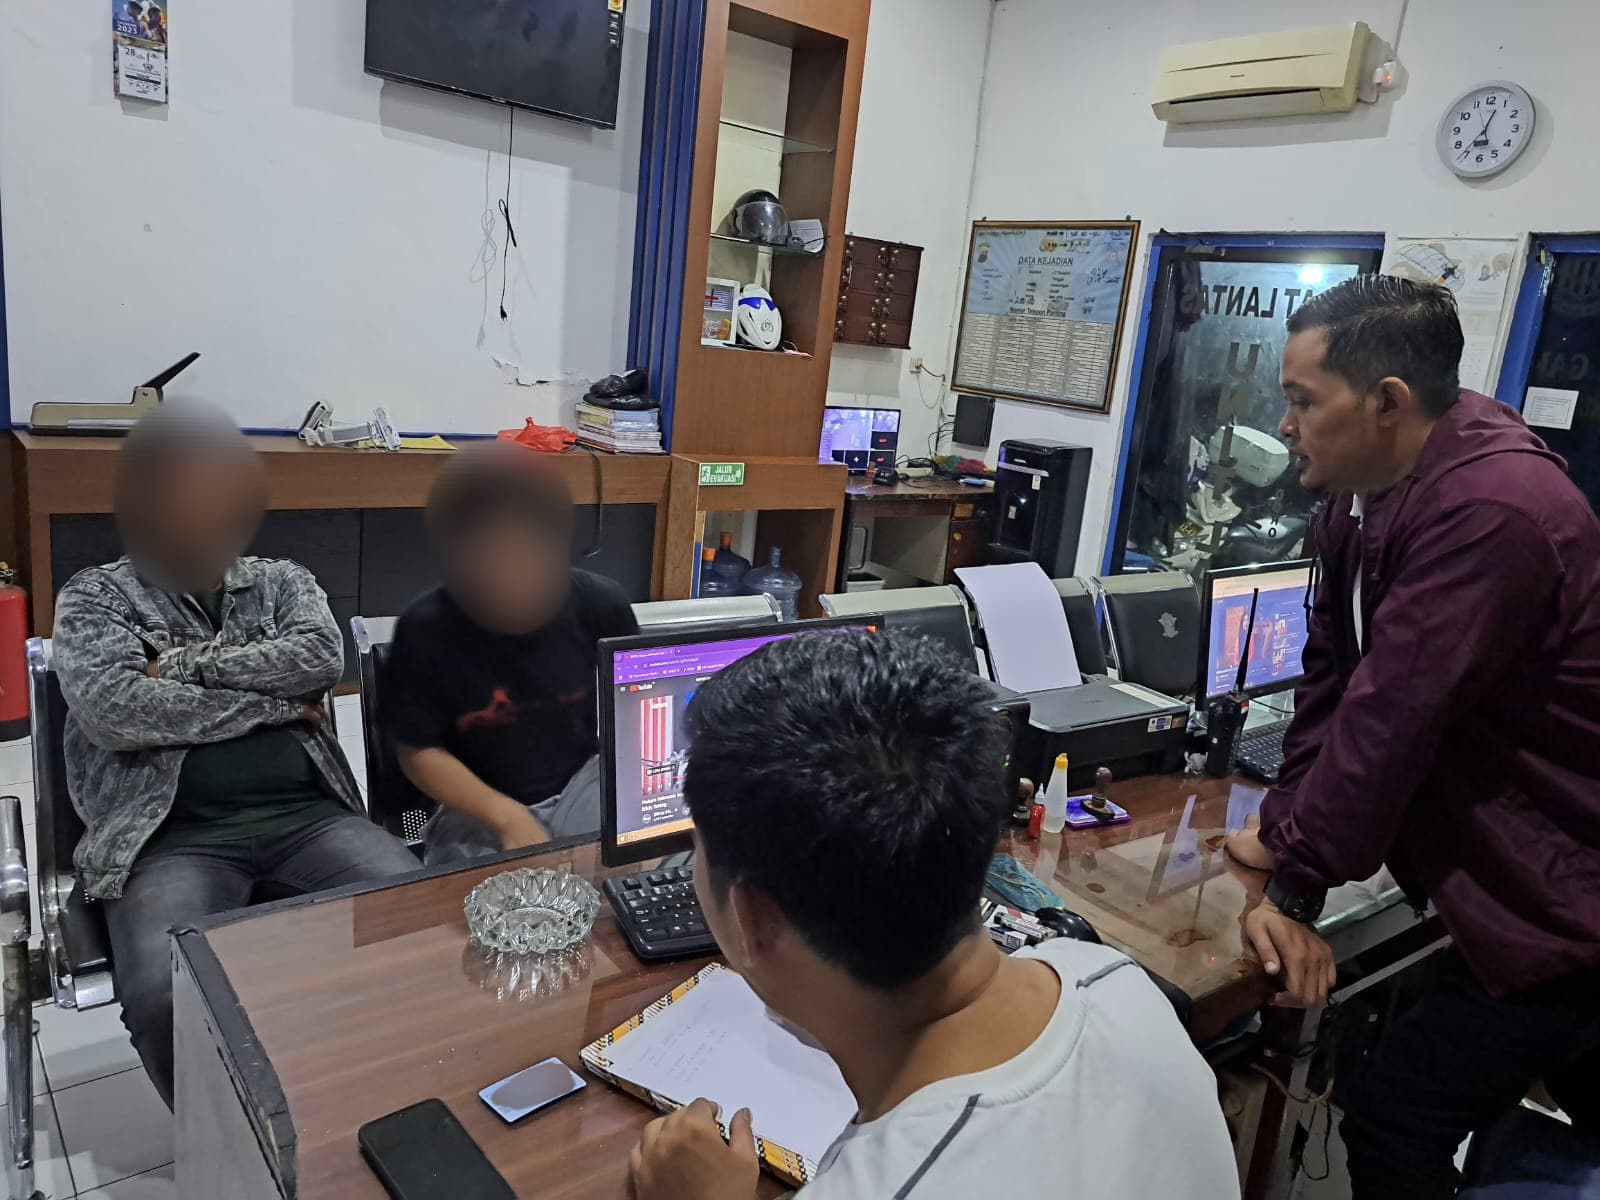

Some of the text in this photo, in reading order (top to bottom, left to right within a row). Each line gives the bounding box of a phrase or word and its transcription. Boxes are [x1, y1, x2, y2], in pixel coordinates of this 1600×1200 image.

[117, 24, 138, 34] 2025
[1473, 100, 1480, 109] 11
[1486, 96, 1497, 105] 12
[1460, 112, 1471, 120] 10
[1510, 110, 1518, 118] 2
[1453, 127, 1461, 135] 9
[1511, 124, 1520, 133] 3
[1454, 141, 1462, 149] 8
[1503, 139, 1511, 147] 4
[1464, 151, 1470, 159] 7
[1490, 150, 1499, 158] 5
[1476, 155, 1484, 163] 6
[1017, 256, 1074, 265] DATA KEJADIAN
[715, 465, 732, 473] JALUR
